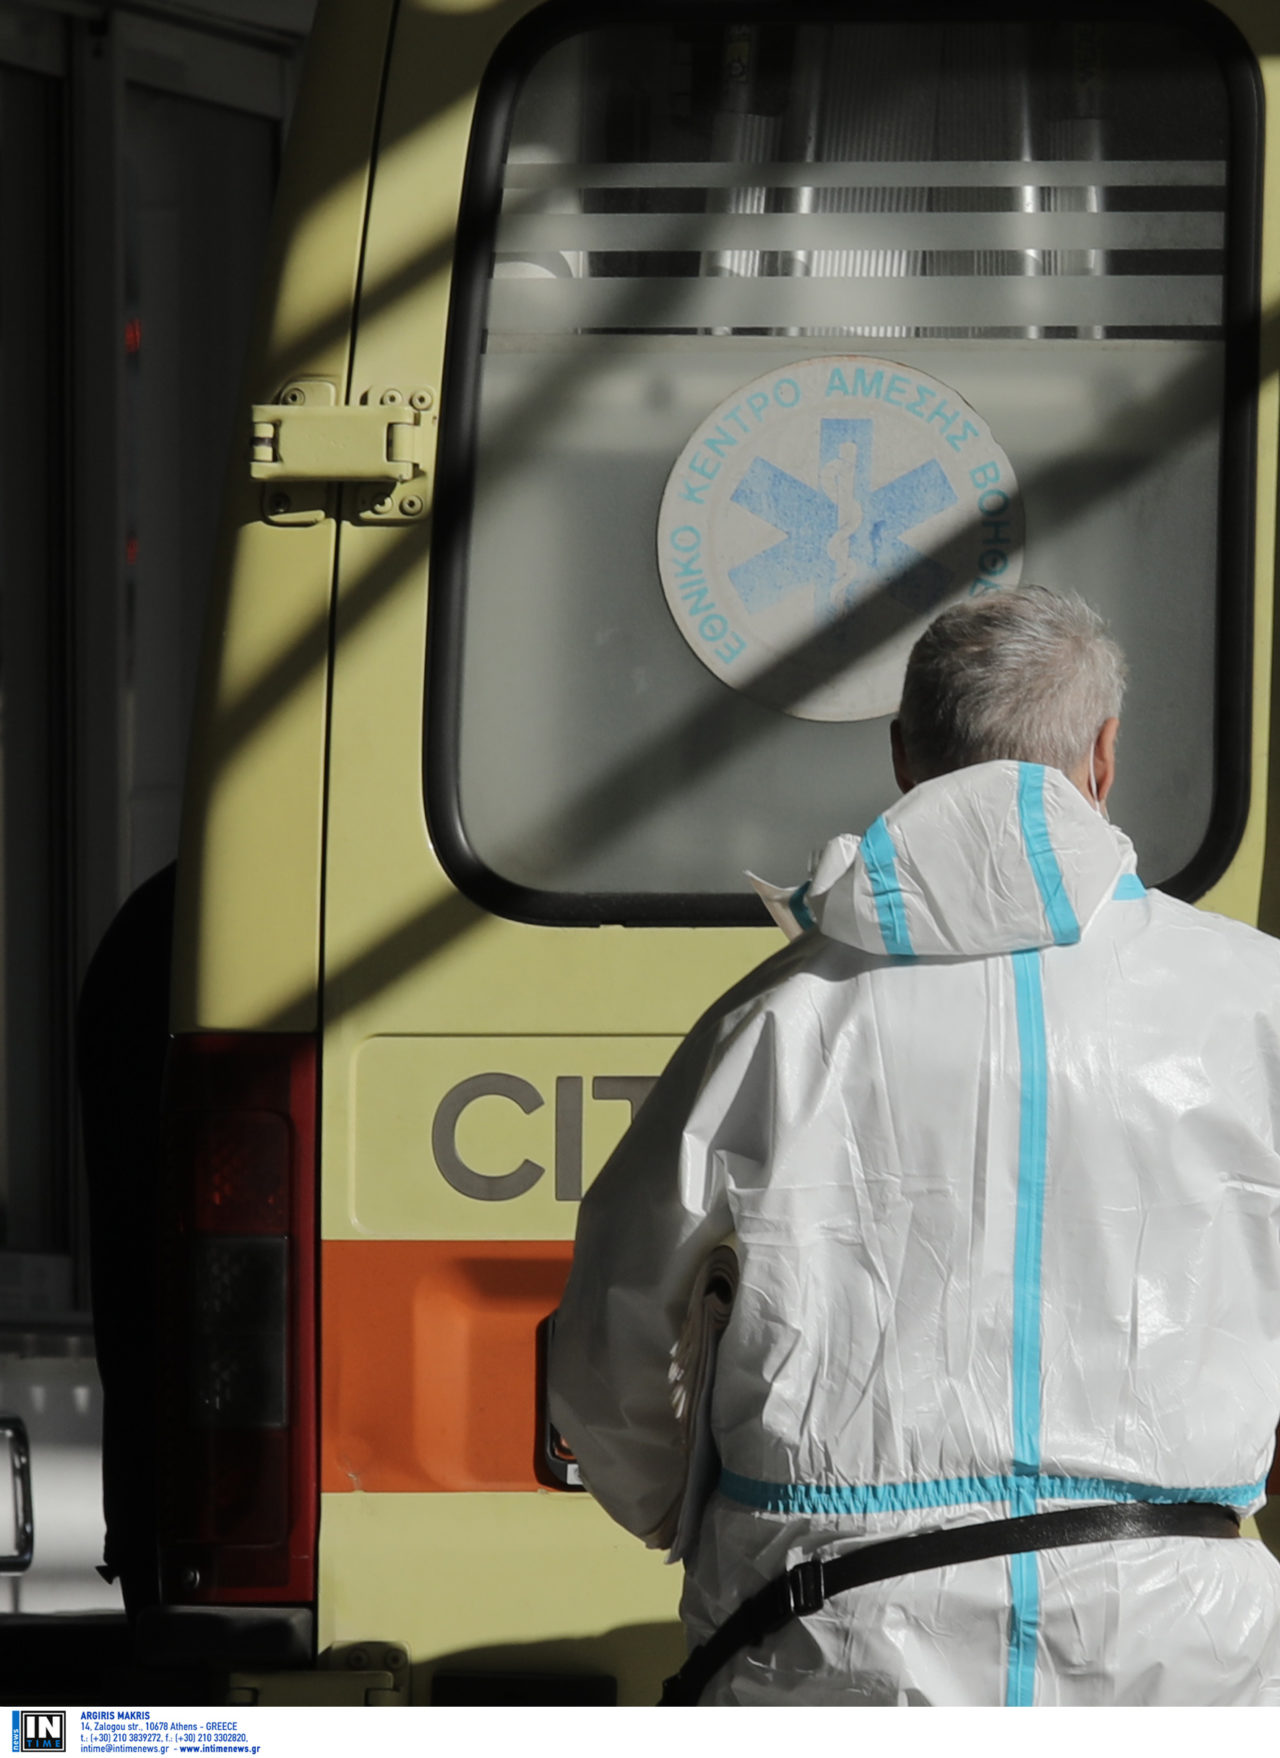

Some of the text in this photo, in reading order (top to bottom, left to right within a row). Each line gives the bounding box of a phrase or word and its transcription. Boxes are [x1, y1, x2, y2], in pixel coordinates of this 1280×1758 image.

[679, 378, 802, 505] ΚΕΝΤΡΟ
[825, 367, 979, 452] ΑΜΕΣΗΣ
[670, 524, 747, 665] ΕΘΝΙΚΟ
